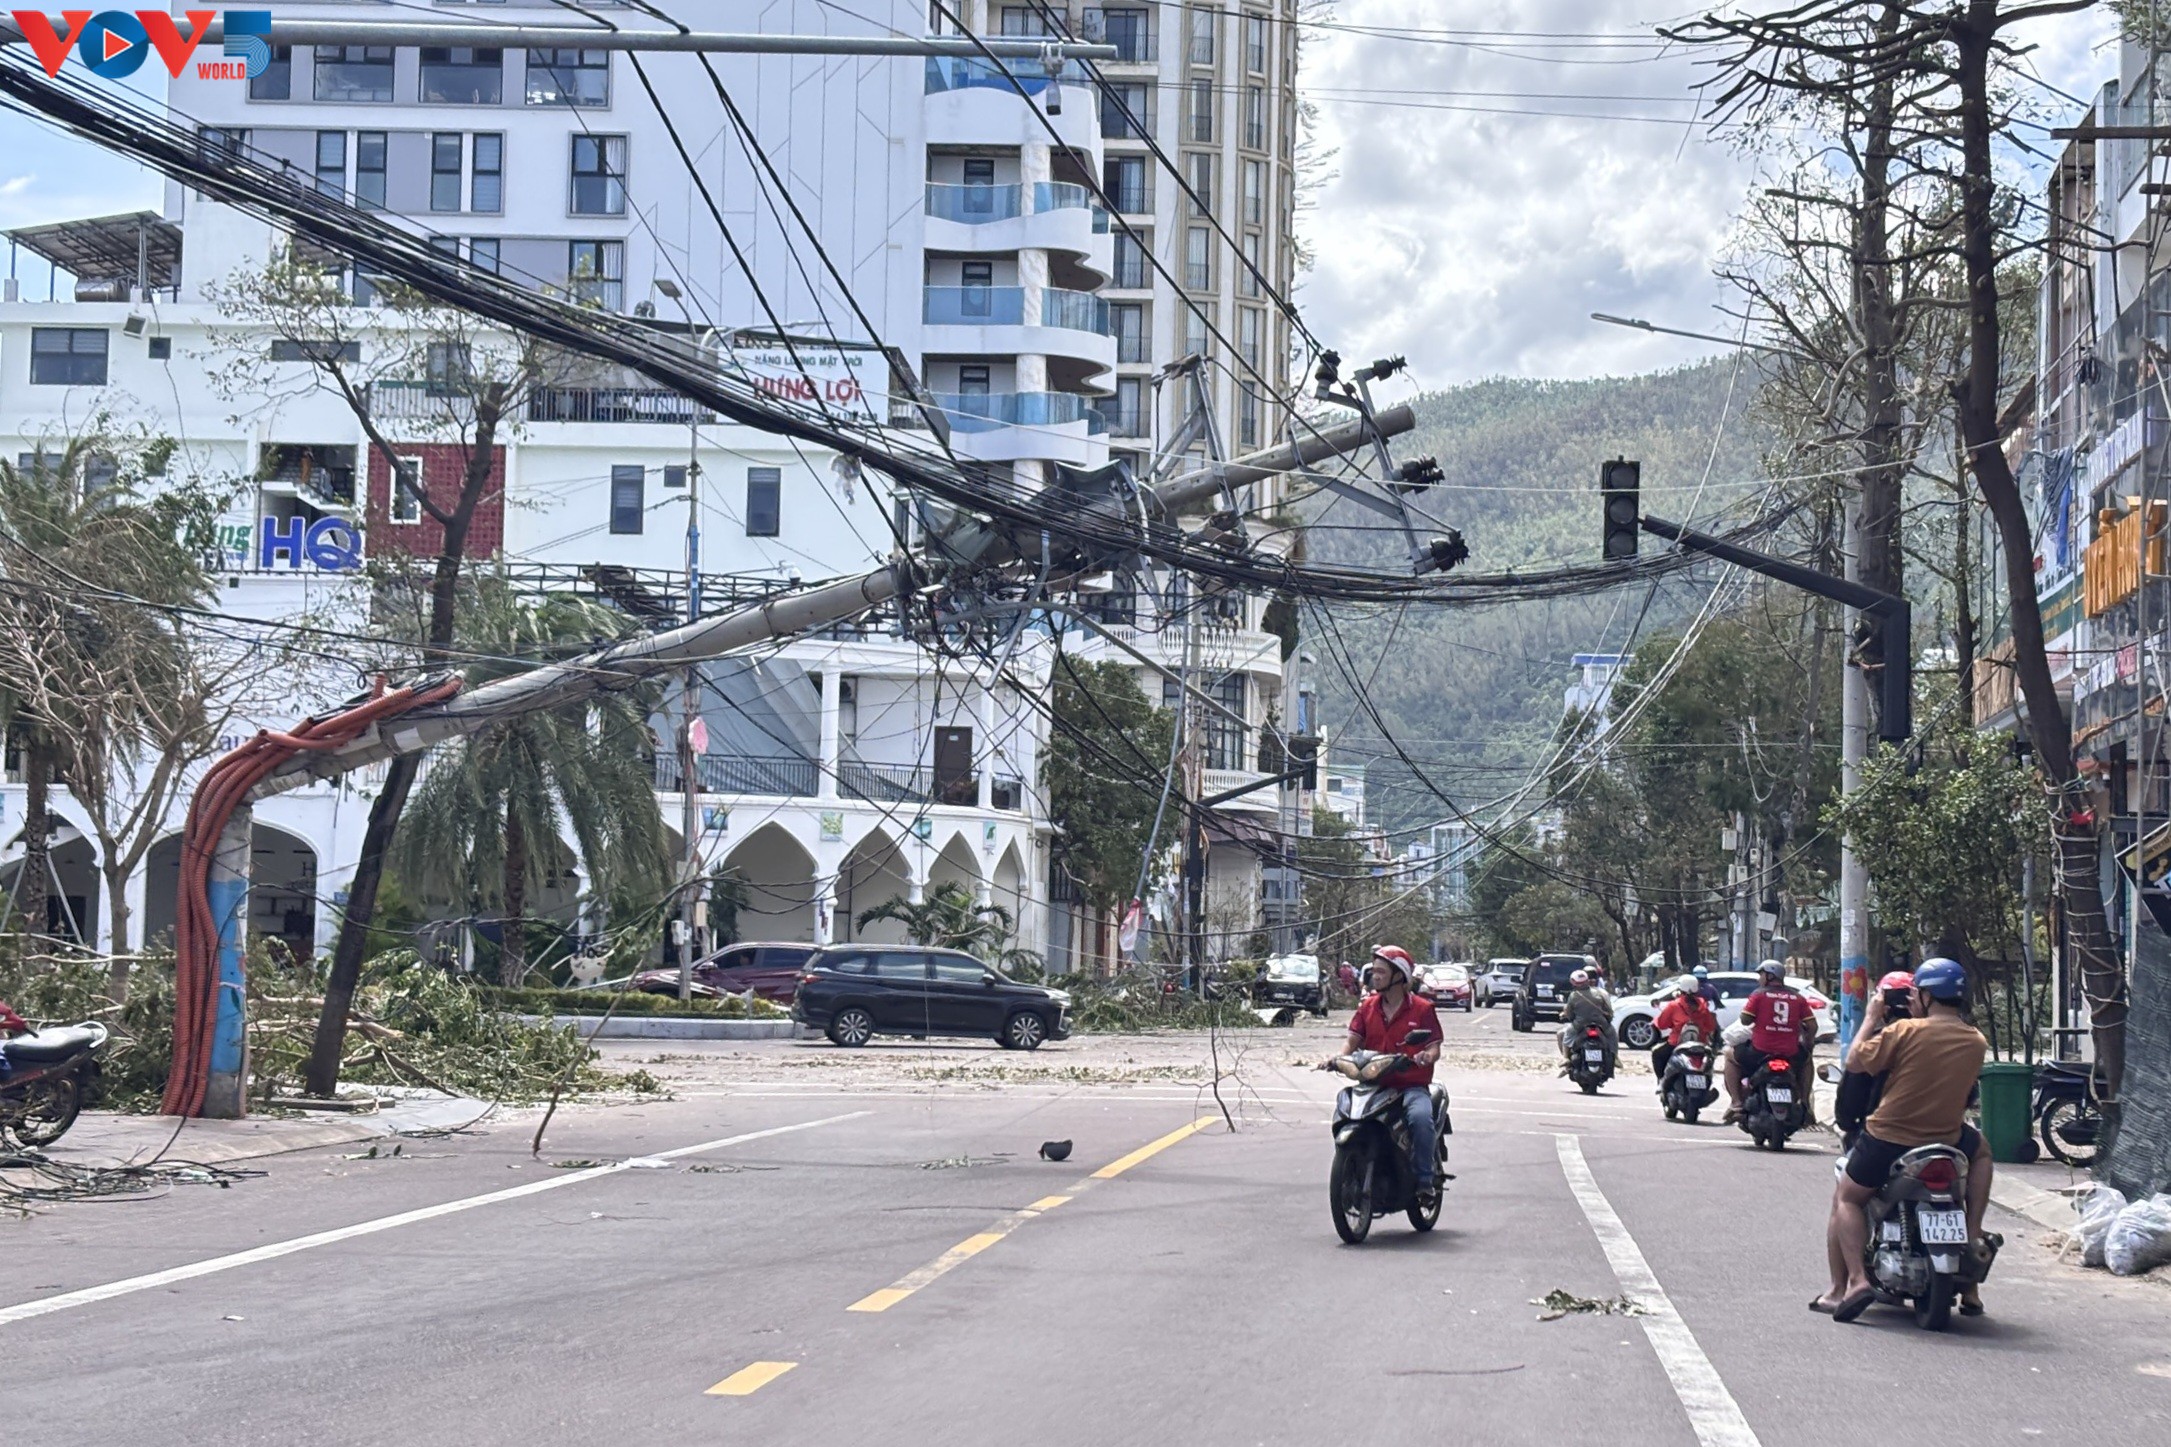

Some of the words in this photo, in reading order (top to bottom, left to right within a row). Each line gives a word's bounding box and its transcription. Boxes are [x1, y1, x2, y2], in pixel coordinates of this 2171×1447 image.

[262, 516, 362, 570] HQ
[1773, 1001, 1789, 1024] 9
[1925, 1228, 1965, 1241] 142.25
